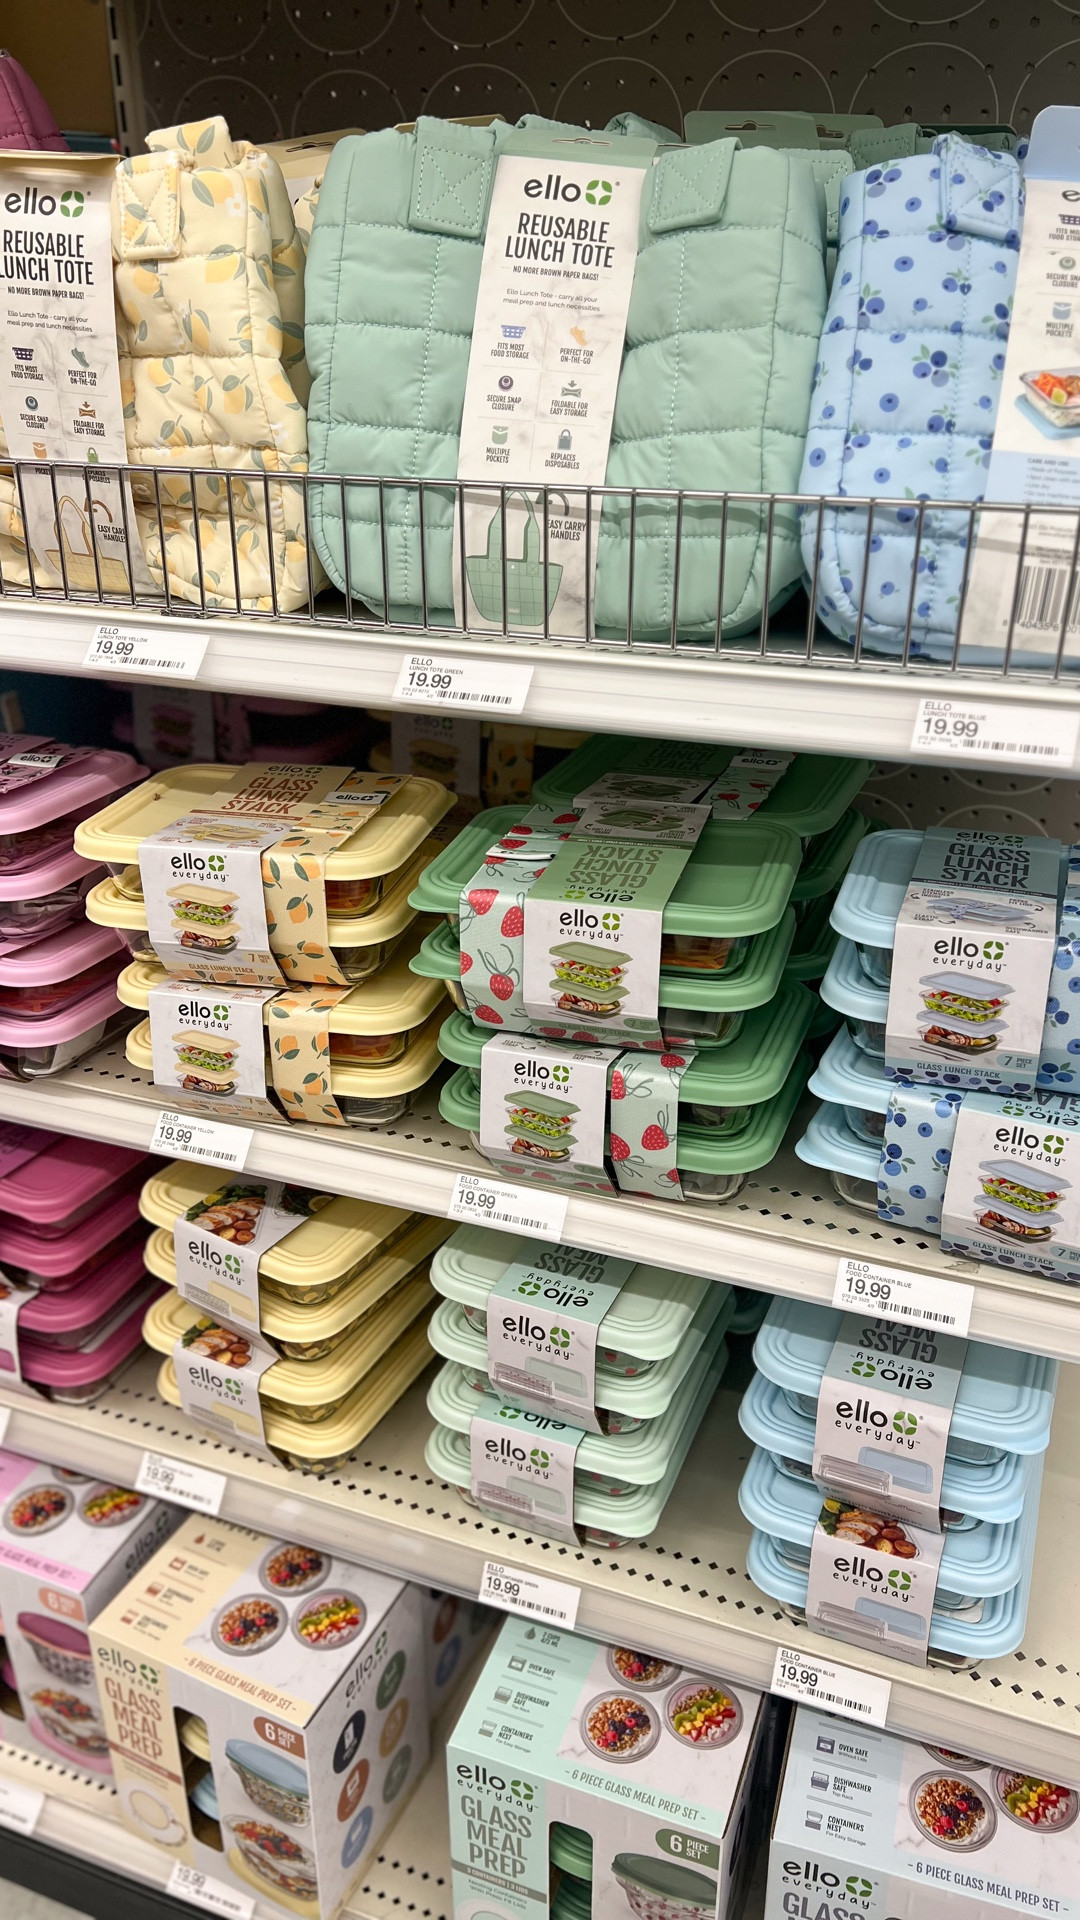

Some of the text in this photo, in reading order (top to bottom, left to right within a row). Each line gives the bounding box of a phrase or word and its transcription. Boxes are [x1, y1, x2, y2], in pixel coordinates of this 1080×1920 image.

[524, 174, 580, 202] ello
[5, 187, 56, 216] ello
[518, 212, 610, 242] REUSABLE
[3, 229, 85, 258] REUSABLE
[505, 236, 614, 268] LUNCH TOTE
[523, 266, 538, 274] MORE
[540, 268, 561, 277] BROWN
[563, 270, 580, 278] PAPER
[582, 272, 598, 280] BAGS!
[8, 286, 84, 300] NO MORE BROWN PAPER BAGS!
[490, 349, 529, 359] FOOD STORAGE
[498, 342, 524, 351] FITS MOST
[560, 348, 581, 356] PERFECT
[560, 355, 591, 364] ON-THE-GO
[487, 395, 521, 404] SECURE SNAP
[492, 403, 514, 412] CLOSURE
[552, 400, 588, 410] FOLDABLE FOR
[550, 407, 588, 417] EASY STORAGE
[486, 448, 510, 456] MULTIPLE
[486, 454, 508, 463] POCKETS
[551, 453, 576, 462] REPLACES
[544, 460, 580, 469] DISPOSABLES
[550, 530, 580, 541] HANDLES
[100, 627, 118, 635] ELLO
[96, 640, 134, 656] 19.99
[411, 658, 432, 666] ELLO
[409, 672, 452, 690] 19.99
[925, 701, 952, 711] ELLO
[968, 714, 987, 722] BLUE
[924, 718, 978, 738] 19.99
[248, 776, 318, 792] GLASS
[233, 788, 308, 803] LUNCH
[221, 800, 296, 814] STACK
[957, 832, 1000, 841] ello
[170, 852, 206, 870] ello
[582, 844, 664, 860] STACK
[948, 842, 1031, 863] GLASS
[573, 858, 658, 876] LUNCH
[944, 856, 1030, 876] LUNCH
[172, 870, 226, 882] everyday
[566, 870, 649, 889] GLASS
[940, 868, 1028, 889] STACK
[588, 892, 634, 903] ello
[560, 908, 598, 928] ello
[560, 928, 620, 942] everyday
[934, 937, 979, 958] ello
[932, 956, 1002, 972] everyday
[178, 1001, 210, 1018] ello
[179, 1018, 229, 1030] everyday
[514, 1060, 550, 1079] ello
[1004, 1056, 1012, 1066] 7
[917, 1062, 1000, 1079] GLASS LUNCH STACK
[514, 1078, 570, 1094] everyday
[162, 1112, 178, 1122] ELLO
[160, 1126, 192, 1144] 19.99
[996, 1126, 1040, 1149] ello
[994, 1144, 1062, 1166] everyday
[460, 1176, 479, 1186] ELLO
[458, 1190, 496, 1210] 19.99
[188, 1241, 222, 1266] ello
[972, 1242, 1054, 1266] GLASS LUNCH STACK
[189, 1254, 242, 1286] everyday
[534, 1253, 604, 1284] GLASS
[848, 1261, 870, 1272] ELLO
[846, 1270, 912, 1288] FOOD CONTAINER BLUE
[846, 1277, 890, 1300] 19.99
[502, 1316, 546, 1341] ello
[503, 1332, 570, 1360] everyday
[858, 1328, 938, 1364] GLASS
[188, 1366, 222, 1388] ello
[880, 1368, 932, 1390] ello
[836, 1399, 888, 1428] ello
[835, 1420, 916, 1450] everyday
[486, 1438, 526, 1462] ello
[146, 1466, 175, 1484] 19.99
[486, 1454, 549, 1480] everyday
[488, 1563, 504, 1574] ELLO
[834, 1556, 884, 1582] ello
[486, 1576, 520, 1596] 19.99
[833, 1572, 909, 1602] everyday
[97, 1648, 136, 1674] ello
[782, 1650, 800, 1662] ELLO
[528, 1663, 556, 1676] OVEN SAFE
[780, 1658, 836, 1678] FOOD CONTAINER BLUE
[780, 1664, 818, 1687] 19.99
[104, 1677, 162, 1722] GLASS
[112, 1700, 162, 1743] MEAL
[118, 1724, 162, 1760] PREP
[498, 1732, 512, 1741] NEST
[838, 1743, 868, 1758] OVEN SAFE
[456, 1764, 506, 1790] ello
[834, 1776, 872, 1794] DISHWASHER
[457, 1779, 533, 1812] everyday
[572, 1769, 700, 1821] 6 PIECE GLASS MEAL PREP SET
[832, 1784, 846, 1793] SAFE
[460, 1794, 532, 1838] GLASS
[828, 1815, 864, 1832] CONTAINERS
[826, 1822, 842, 1833] NEST
[467, 1819, 528, 1862] MEAL
[669, 1834, 710, 1854] 6 PIECE
[470, 1842, 526, 1879] PREP
[686, 1848, 702, 1860] SET
[782, 1860, 840, 1888] ello
[782, 1876, 870, 1910] everyday
[916, 1862, 1060, 1913] 6 PIECE GLASS MEAL PREP SET
